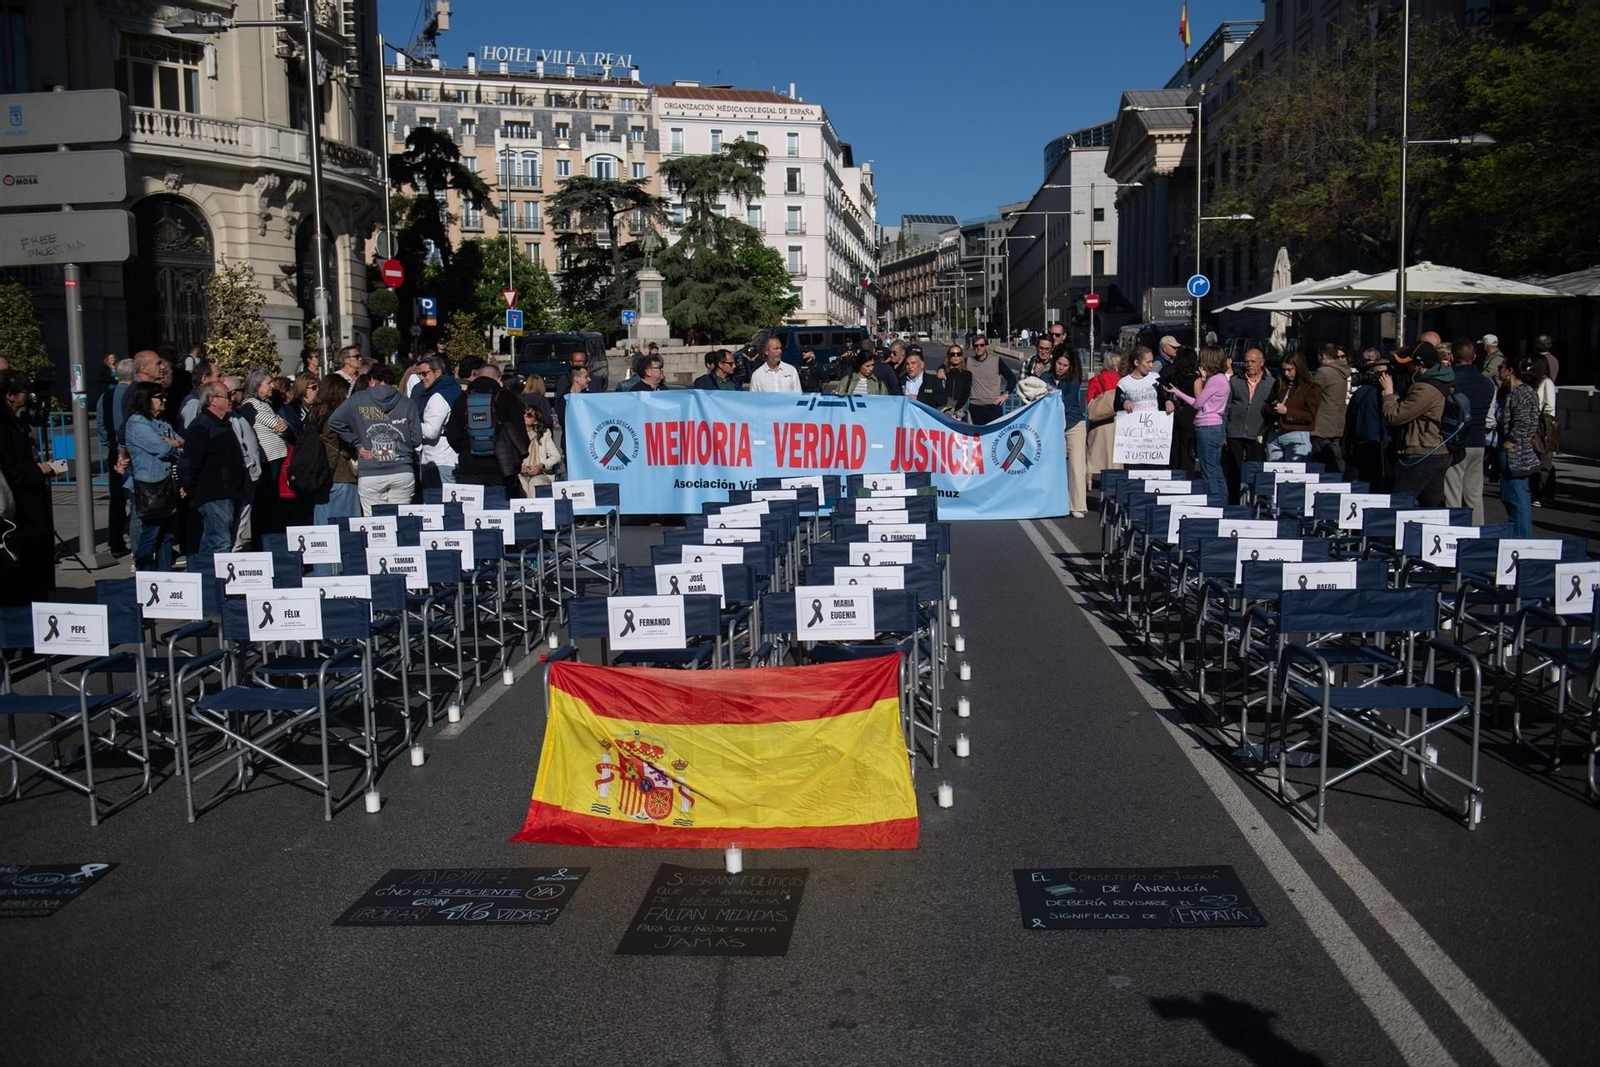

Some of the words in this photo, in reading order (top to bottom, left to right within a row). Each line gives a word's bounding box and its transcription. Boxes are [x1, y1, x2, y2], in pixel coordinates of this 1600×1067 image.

[484, 46, 534, 62] HOTEL
[541, 49, 587, 66] VILLA
[594, 52, 634, 69] REAL
[664, 102, 714, 111] ORGANIZACIÓN
[716, 104, 742, 113] MÉDICA
[743, 106, 777, 114] COLEGIAL
[790, 108, 814, 116] ESPAÑA
[15, 178, 39, 186] MOSA
[20, 233, 58, 251] FREE
[28, 240, 86, 258] PALESTINA
[1164, 300, 1193, 308] telpark
[1139, 412, 1153, 428] 46
[645, 421, 752, 467] MEMORIA
[773, 422, 866, 470] VERDAD
[890, 426, 985, 475] JUSTICIA
[1124, 451, 1164, 460] JUSTICIA
[673, 478, 736, 491] Asociación
[238, 569, 263, 577] NATIVIDAD
[690, 573, 704, 583] JOSÉ
[688, 584, 706, 593] MARÍA
[169, 590, 183, 599] JOSÉ
[833, 599, 855, 608] MARIA
[284, 608, 301, 618] FÉLIX
[830, 611, 857, 620] EUGENIA
[639, 618, 671, 627] FERNANDO
[71, 625, 86, 634] PEPE
[667, 872, 735, 887] SOBRAN
[1031, 872, 1050, 882] EL
[438, 888, 522, 897] SUFICIENTE
[1102, 884, 1121, 893] DE
[1132, 882, 1209, 893] ANDALUCÍA
[1045, 897, 1107, 907] DEBERÍA
[438, 902, 494, 921] 46
[643, 907, 707, 921] FALTAN
[715, 908, 789, 922] MEDIDAS
[1049, 912, 1130, 920] SIGNIFICADO
[1142, 912, 1158, 920] DE
[1174, 907, 1248, 923] EMPATÍA
[636, 924, 664, 933] PARA
[653, 935, 746, 949] JAMÁS
